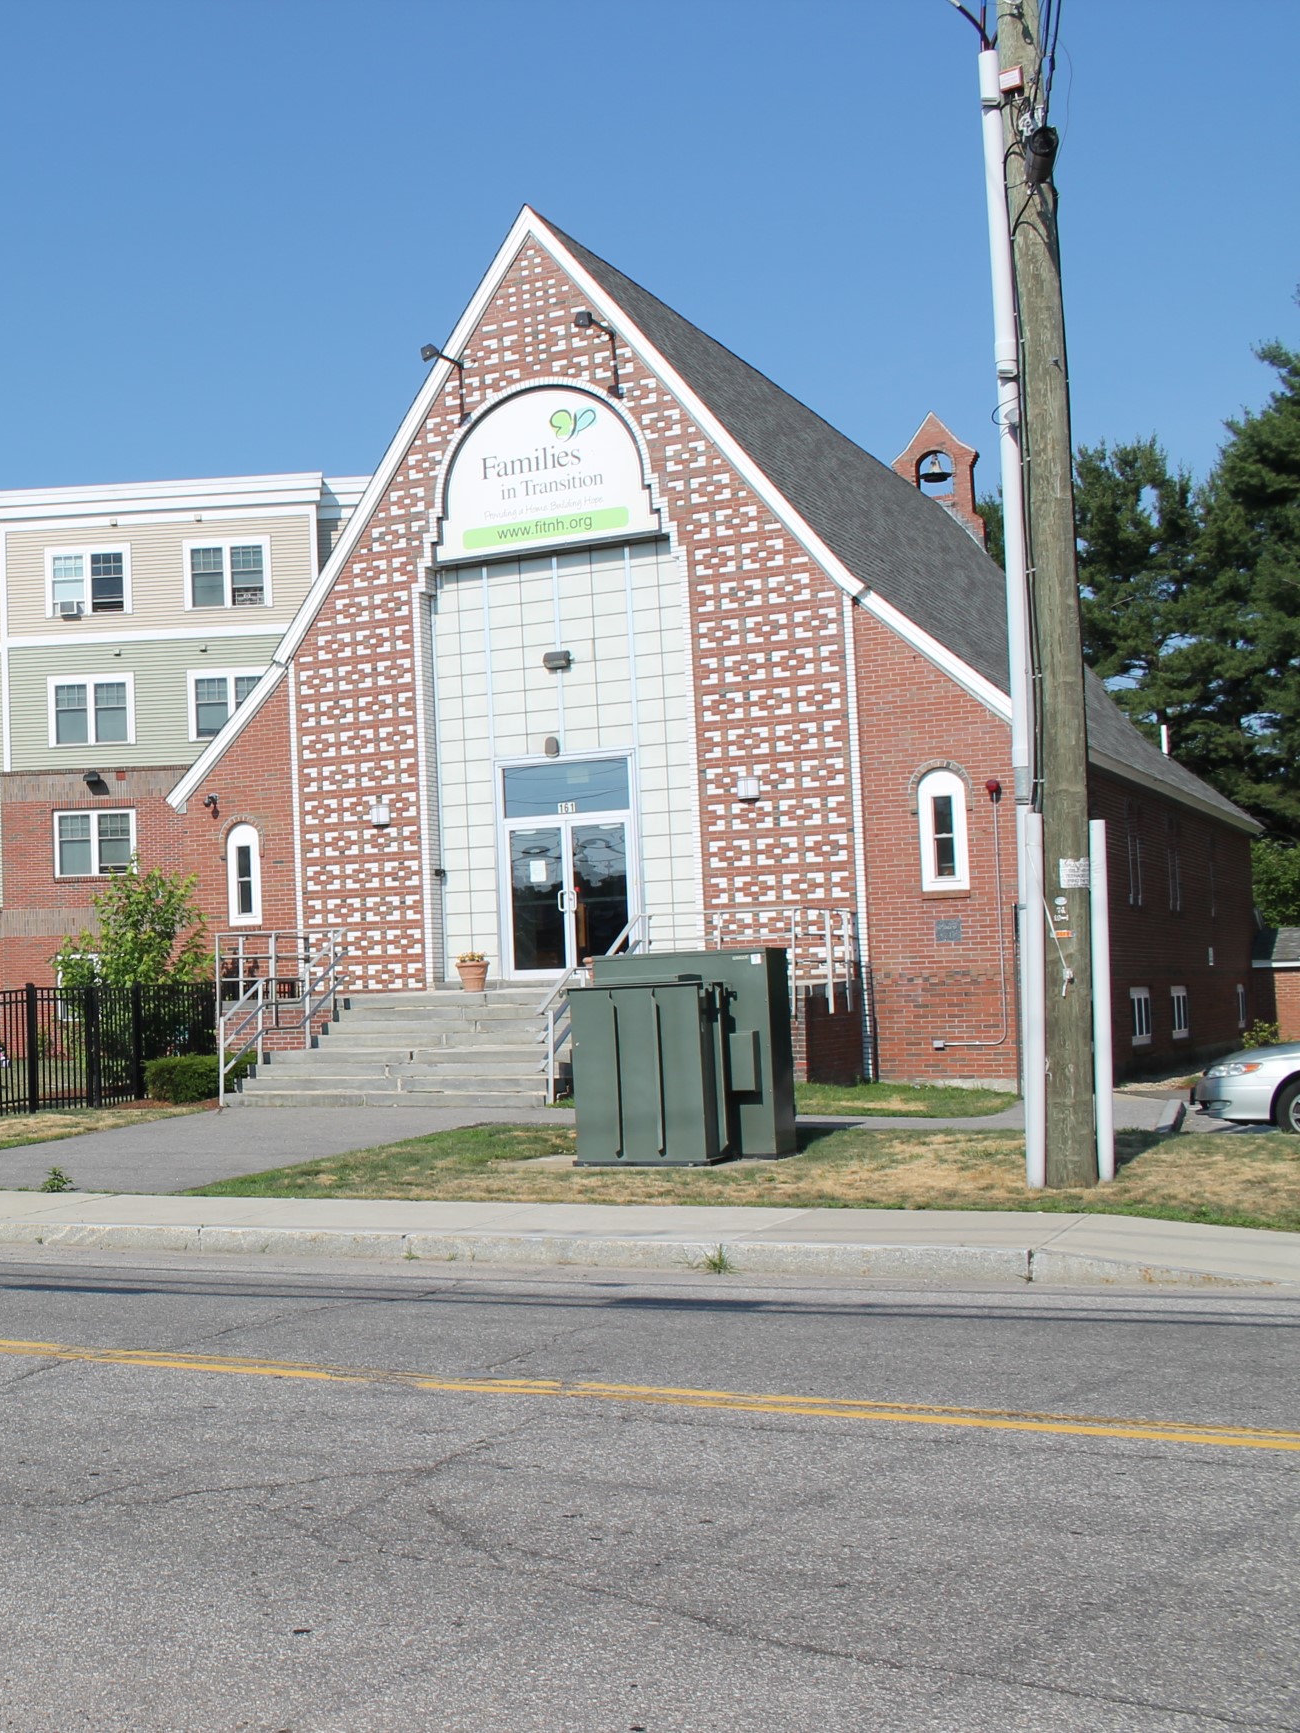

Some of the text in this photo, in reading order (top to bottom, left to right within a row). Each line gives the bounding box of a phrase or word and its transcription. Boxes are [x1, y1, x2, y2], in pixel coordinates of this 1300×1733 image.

[480, 446, 582, 481] Families
[501, 471, 604, 500] in Transition
[497, 516, 593, 540] www.fitnh.org
[559, 803, 575, 813] 161
